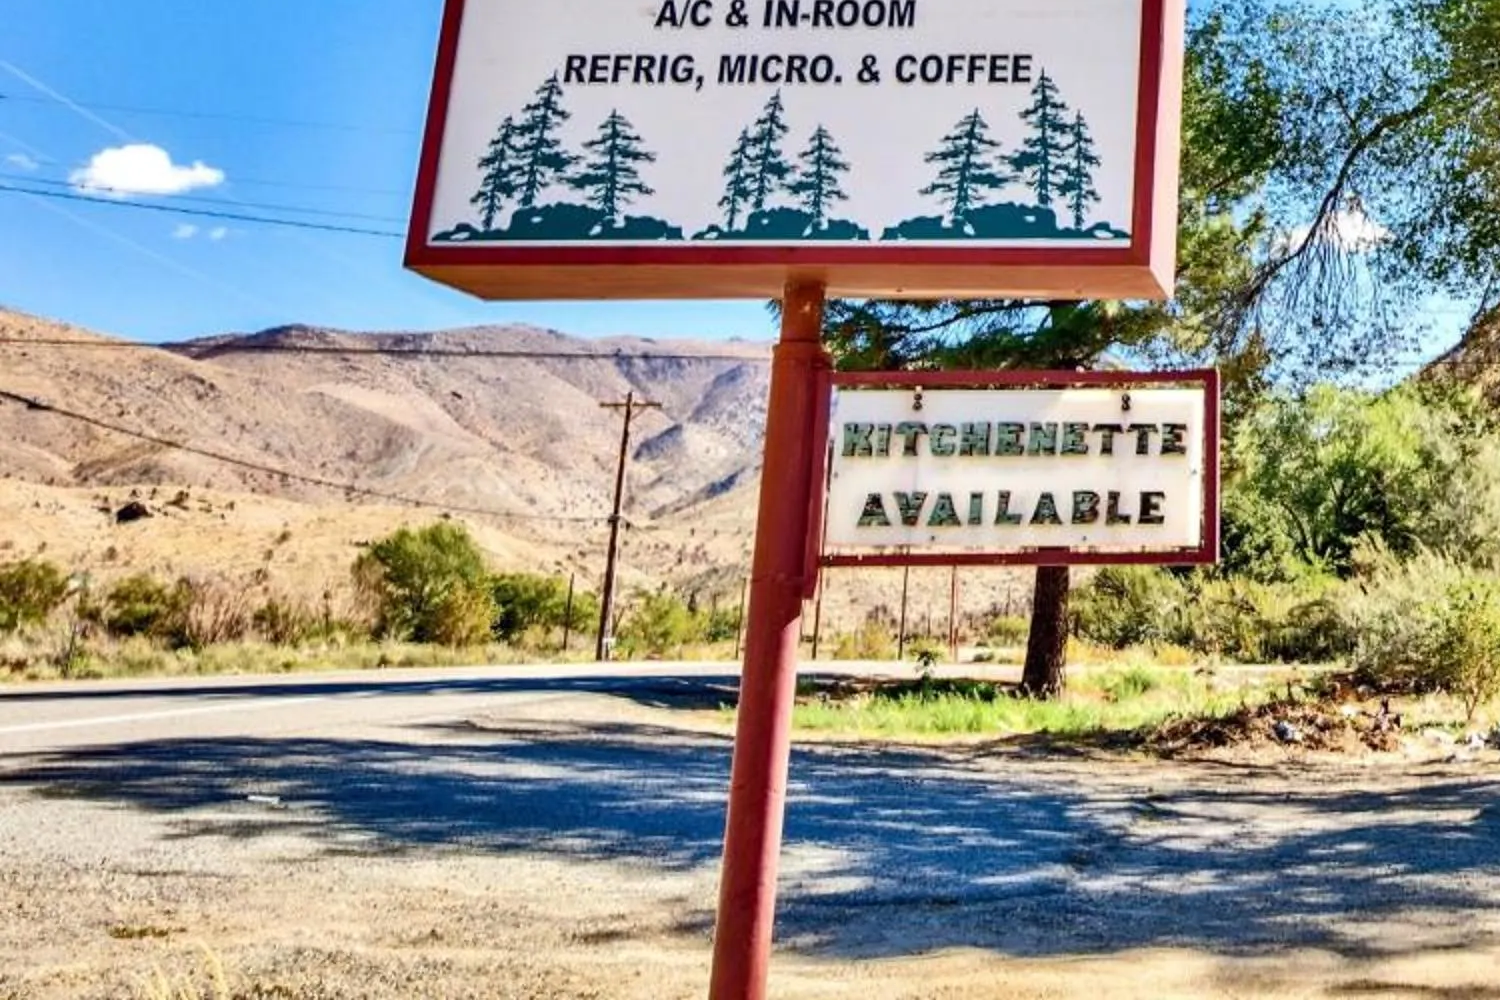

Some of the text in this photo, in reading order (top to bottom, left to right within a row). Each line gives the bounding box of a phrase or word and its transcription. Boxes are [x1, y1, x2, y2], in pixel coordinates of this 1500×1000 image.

[655, 0, 917, 29] A/C & IN-ROOM
[563, 55, 1034, 92] REFRIG, MICRO. & COFFEE
[841, 421, 1188, 458] KITCHENETTE
[856, 489, 1166, 528] AVAILABLE
